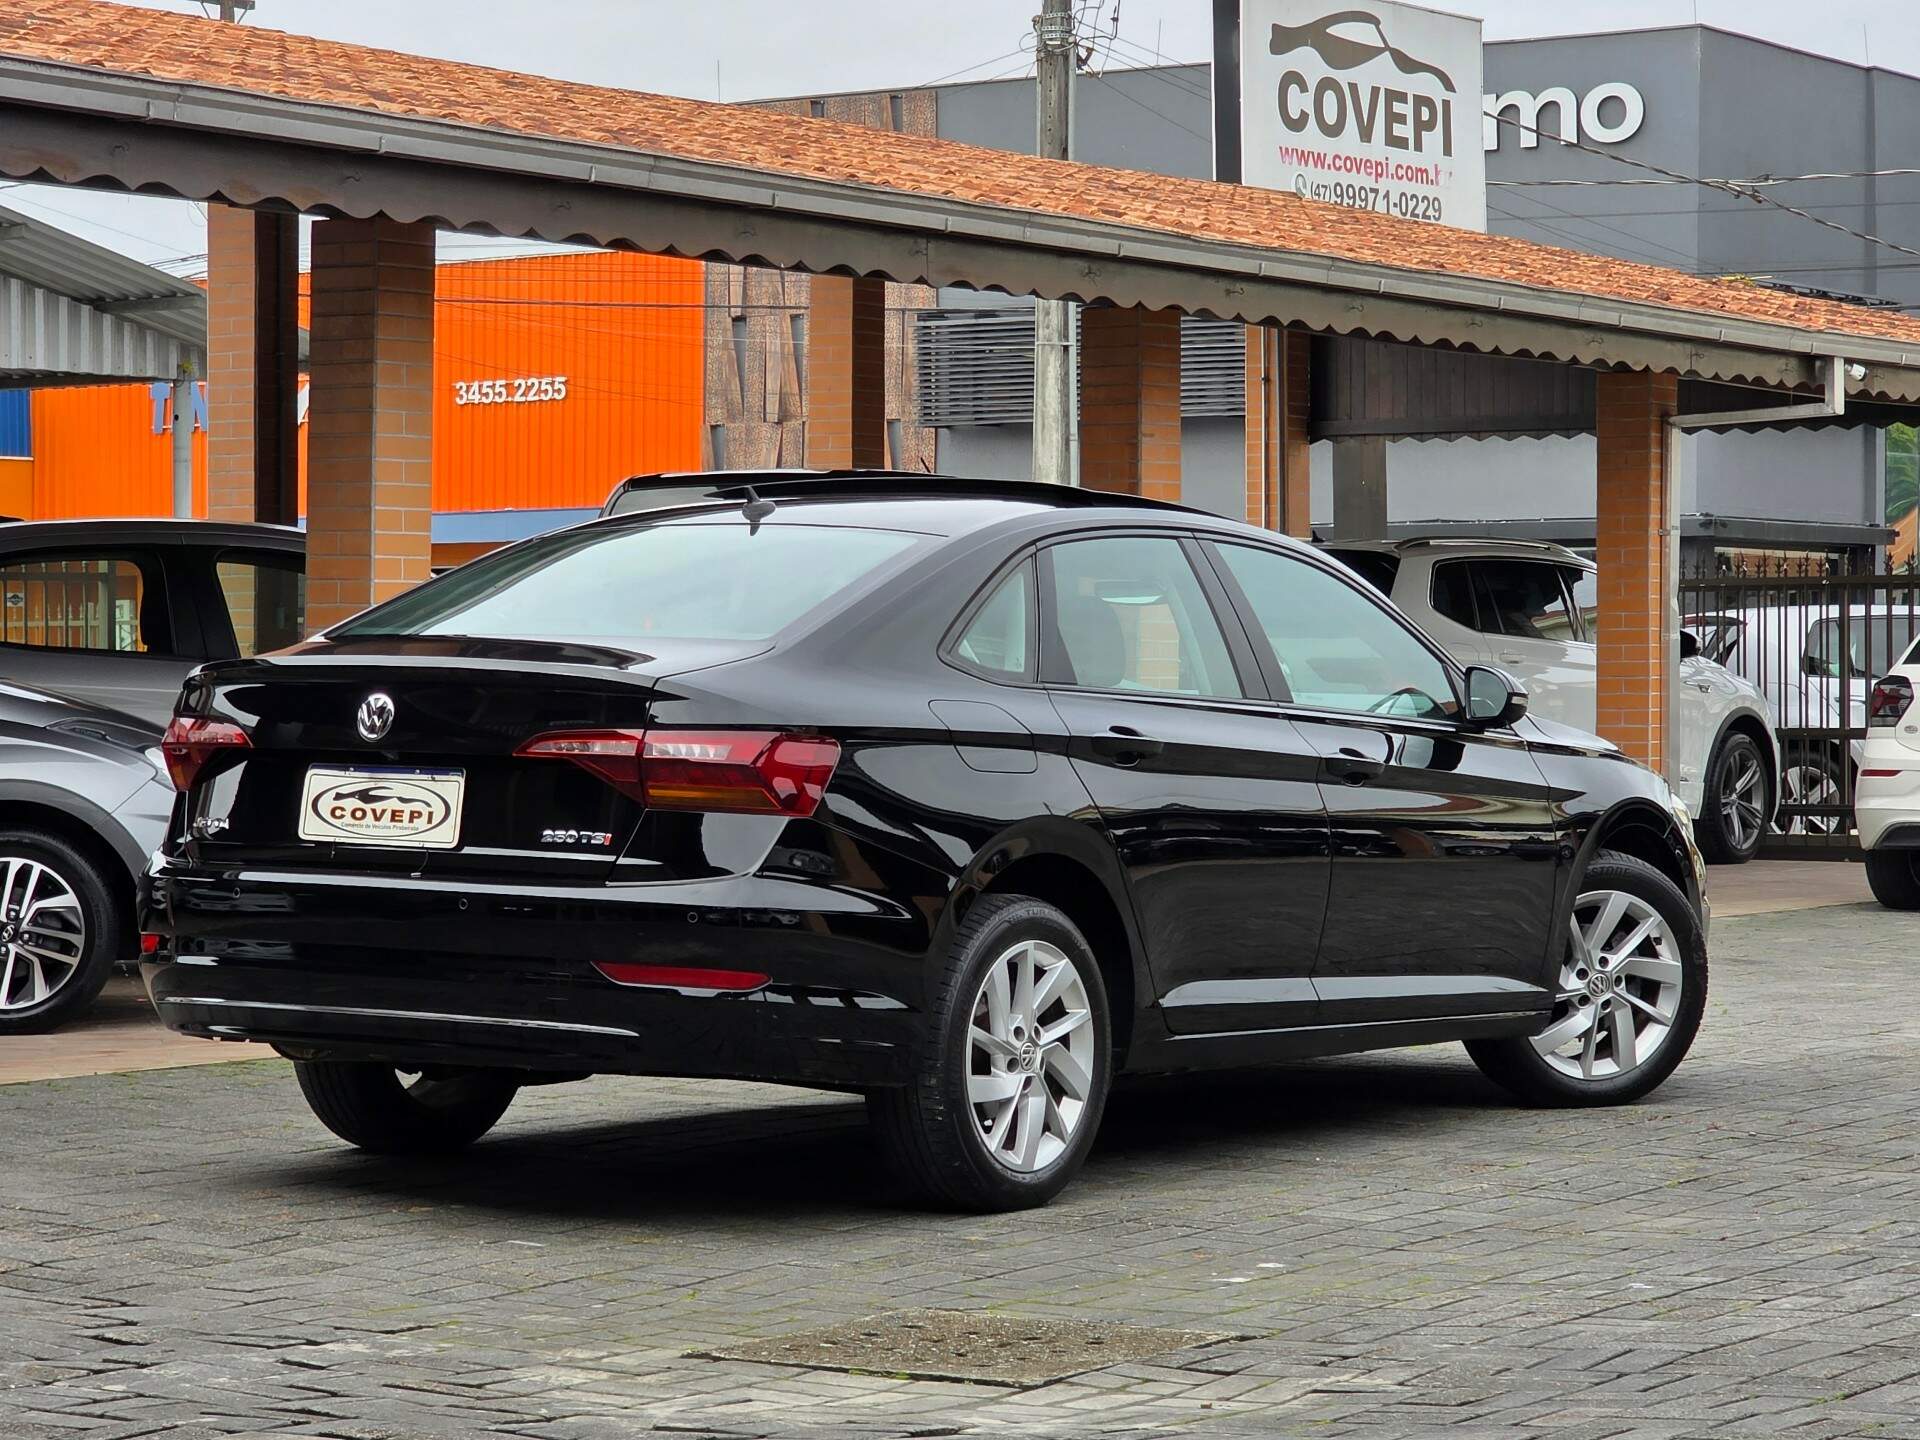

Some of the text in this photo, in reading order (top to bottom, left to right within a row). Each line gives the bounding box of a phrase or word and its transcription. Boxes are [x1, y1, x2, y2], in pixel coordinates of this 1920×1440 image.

[1277, 70, 1454, 157] COVEPI
[455, 376, 567, 405] 3455.2255
[330, 806, 434, 825] COVEPI
[540, 829, 578, 844] 250
